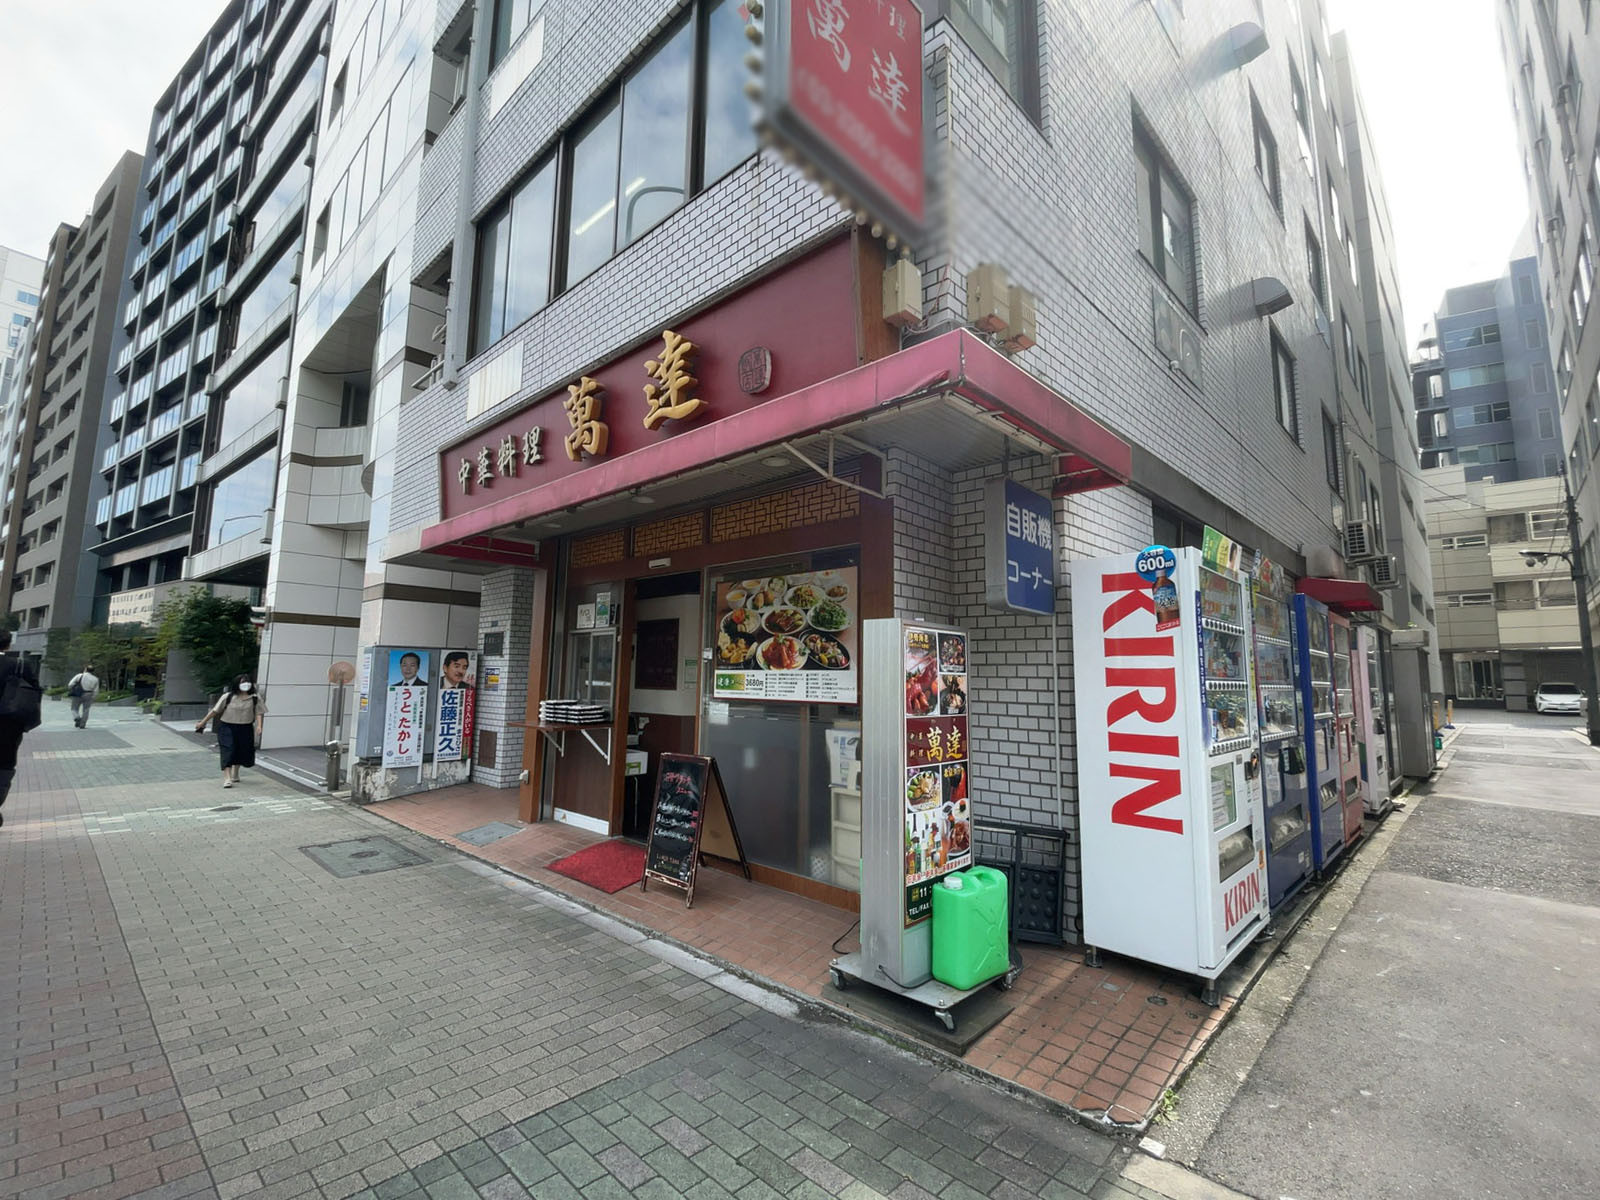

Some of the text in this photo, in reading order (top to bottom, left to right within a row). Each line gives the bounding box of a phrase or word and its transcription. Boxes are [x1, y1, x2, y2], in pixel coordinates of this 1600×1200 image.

[457, 425, 545, 496] 中華料理
[561, 329, 709, 463] 萬達
[1006, 502, 1052, 550] 自販機
[1007, 560, 1053, 590] コーナー
[1138, 556, 1174, 573] 600ml
[398, 688, 412, 755] うとたかし
[438, 690, 459, 752] 佐藤正久
[1101, 573, 1184, 835] KIRIN
[926, 725, 963, 762] 萬達
[908, 902, 930, 915] TEL/FAX
[1223, 872, 1261, 932] KIRIN
